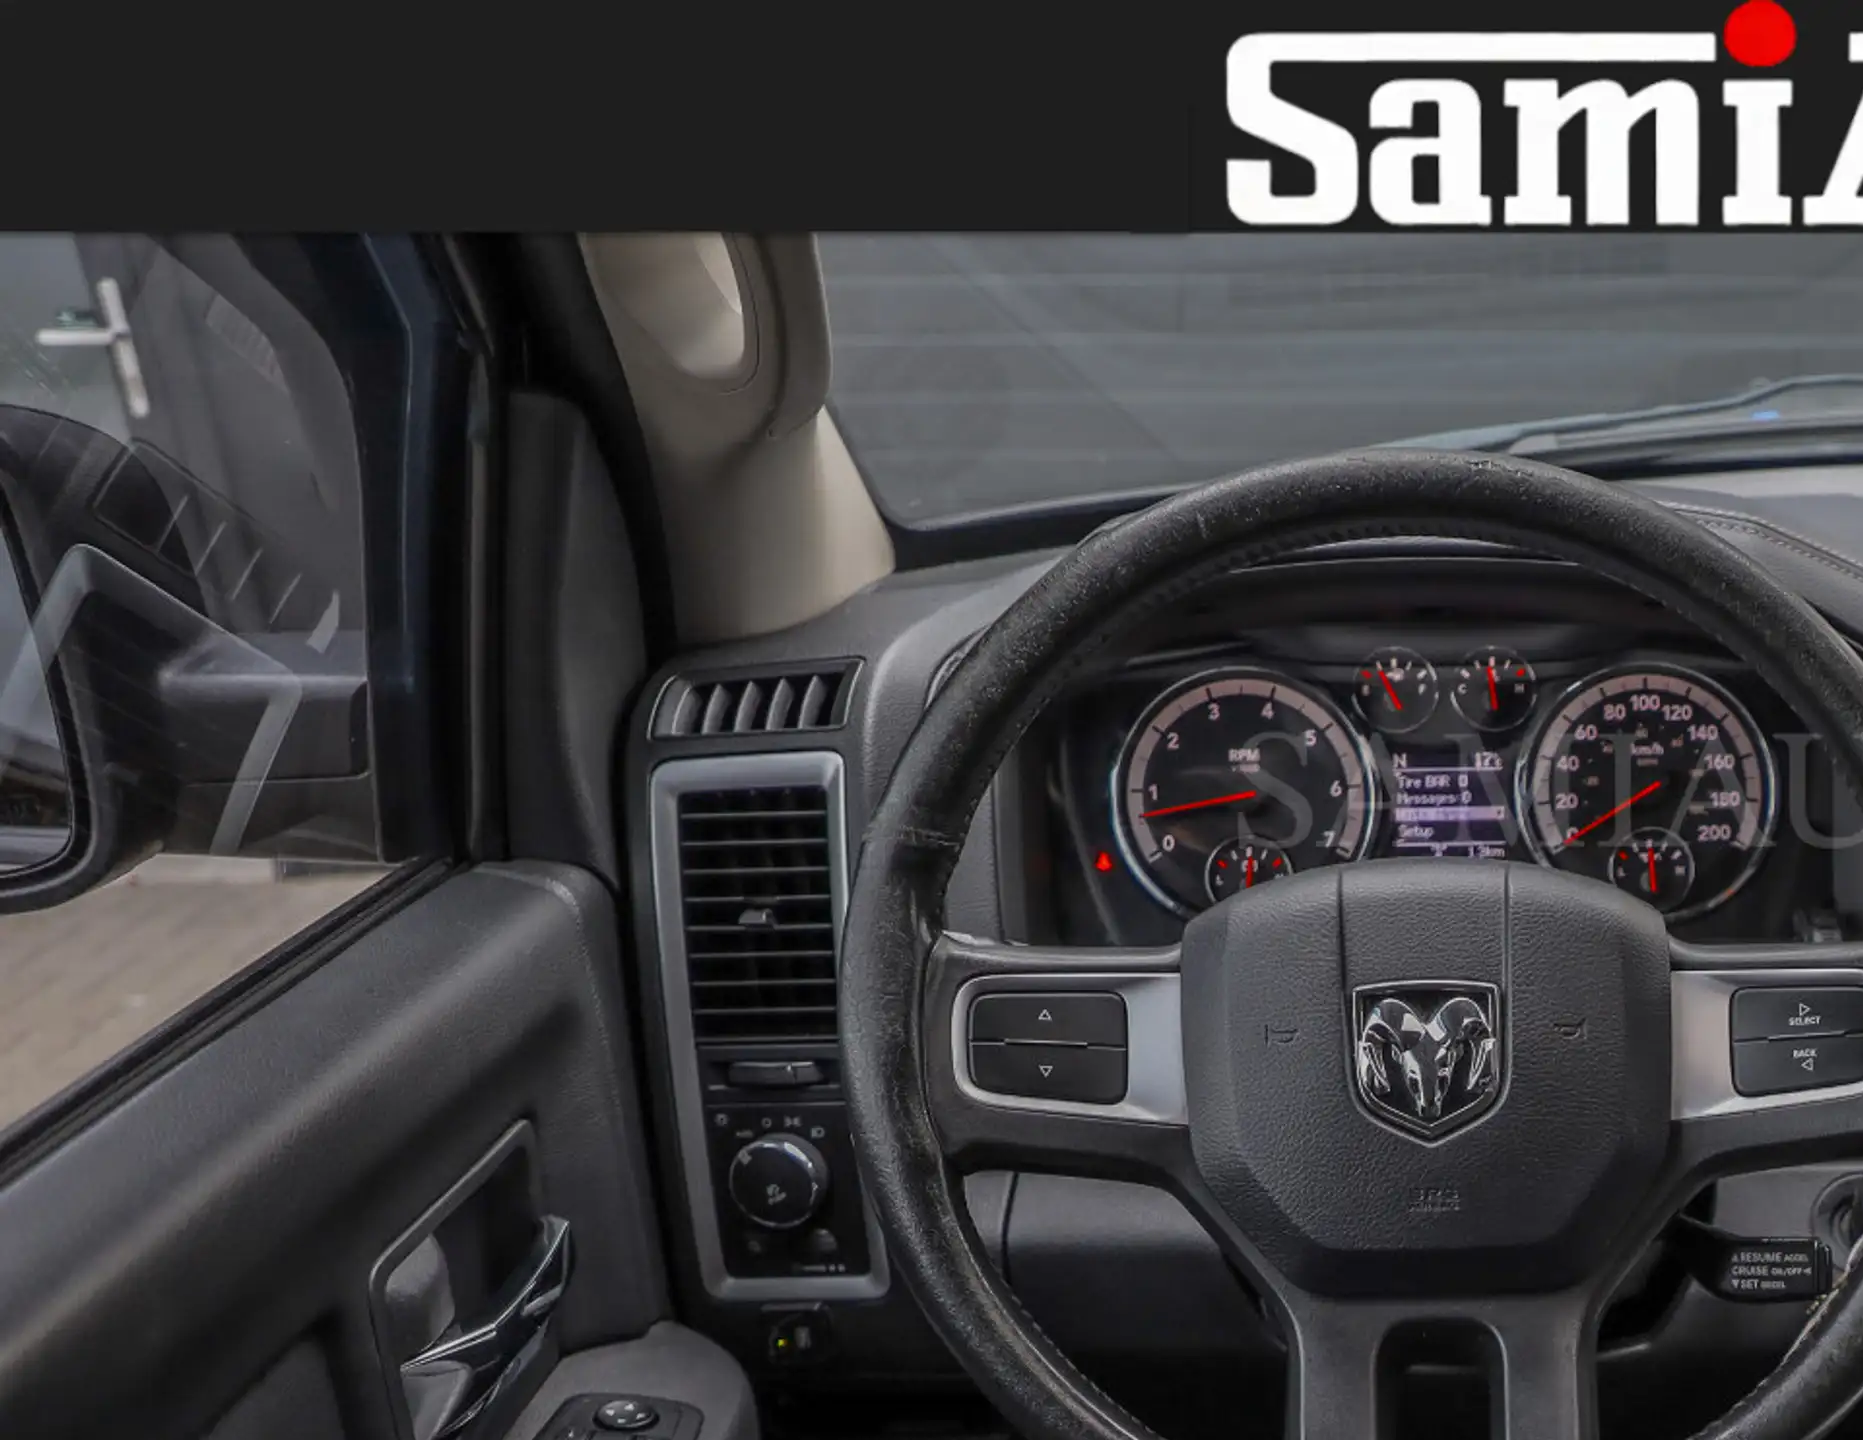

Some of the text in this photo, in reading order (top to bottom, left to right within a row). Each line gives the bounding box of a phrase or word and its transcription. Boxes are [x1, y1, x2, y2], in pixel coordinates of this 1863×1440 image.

[1260, 702, 1275, 720] 4
[1629, 694, 1661, 712] 100
[1207, 703, 1221, 721] 3
[1602, 703, 1627, 721] 80
[1661, 704, 1693, 721] 120
[1166, 732, 1180, 750] 2
[1303, 728, 1318, 747] 5
[1574, 724, 1598, 741] 60
[1687, 724, 1719, 741] 140
[1228, 748, 1261, 763] RPM
[1630, 742, 1665, 756] km/h
[1392, 753, 1408, 769] N
[1556, 755, 1580, 772] 40
[1703, 754, 1735, 771] 160
[1149, 784, 1159, 801] 1
[1329, 780, 1343, 797] 6
[1555, 793, 1579, 809] 20
[1709, 790, 1741, 808] 180
[1323, 830, 1337, 847] 7
[1398, 825, 1435, 839] Setup
[1697, 824, 1731, 841] 200
[1161, 836, 1176, 852] 0
[1787, 1015, 1822, 1027] SELECT
[1792, 1048, 1818, 1059] BACK
[1740, 1252, 1783, 1263] RESUME
[1731, 1265, 1769, 1277] CRUISE
[1740, 1279, 1760, 1290] SET
